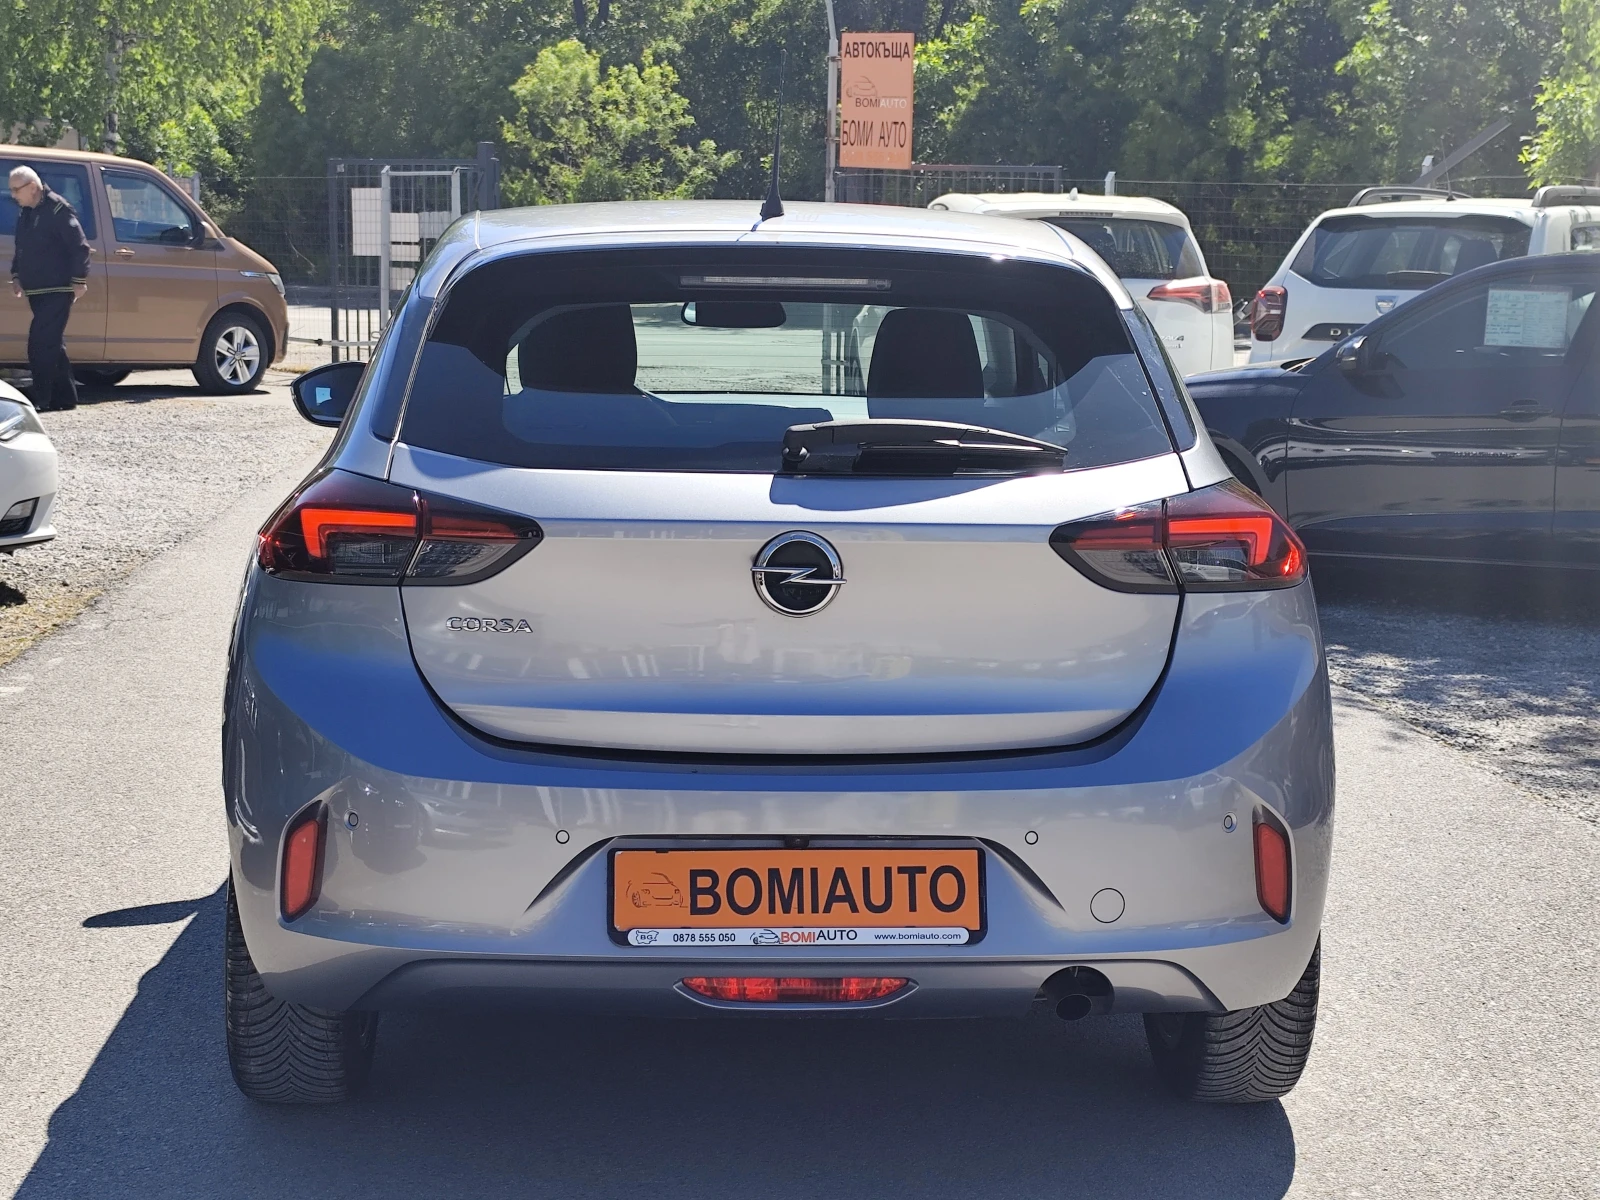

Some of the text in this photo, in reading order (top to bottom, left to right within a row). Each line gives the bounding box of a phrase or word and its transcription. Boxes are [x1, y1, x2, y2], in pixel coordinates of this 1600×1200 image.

[844, 41, 911, 61] АВТОКЪЩА
[855, 97, 907, 109] BOMIAUTO
[842, 120, 907, 148] БОМИ АУТО
[446, 616, 533, 633] CORSA
[689, 865, 966, 916] BOMIAUTO
[672, 933, 696, 942] 0878
[698, 933, 716, 942] 555
[718, 933, 736, 942] 050
[781, 929, 858, 943] BOMIAUTO
[874, 932, 961, 940] www.bomiauto.com
